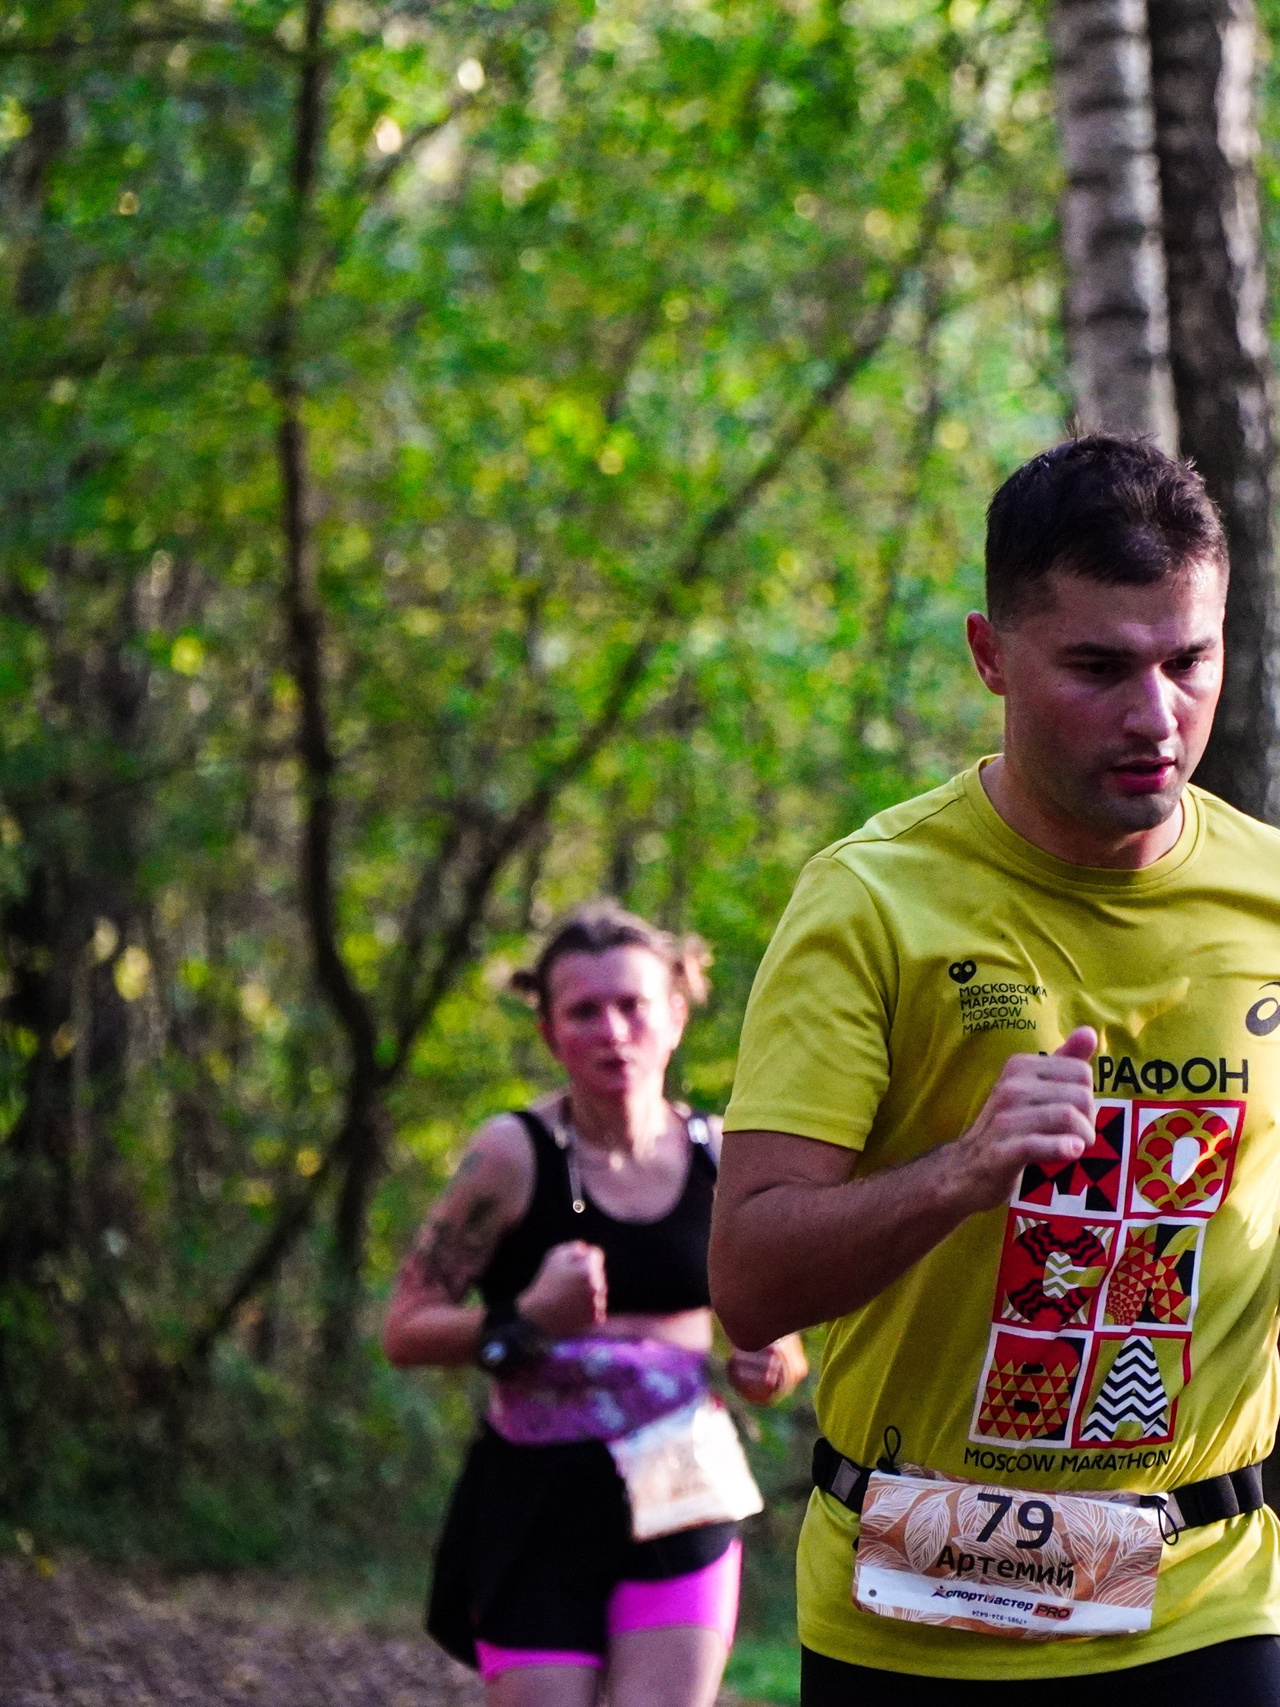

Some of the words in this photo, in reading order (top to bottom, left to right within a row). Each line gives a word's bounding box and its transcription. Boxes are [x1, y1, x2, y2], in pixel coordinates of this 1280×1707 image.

[960, 995, 1029, 1010] МАРАФОН
[962, 1006, 1022, 1023] MOSCOW
[962, 1019, 1037, 1036] MARATHON
[1092, 1055, 1250, 1095] РАФОН
[963, 1447, 1055, 1473] MOSCOW
[1060, 1449, 1171, 1473] MARATHON
[975, 1492, 1055, 1550] 79
[935, 1544, 1076, 1589] Артемий
[1035, 1603, 1071, 1619] PRO
